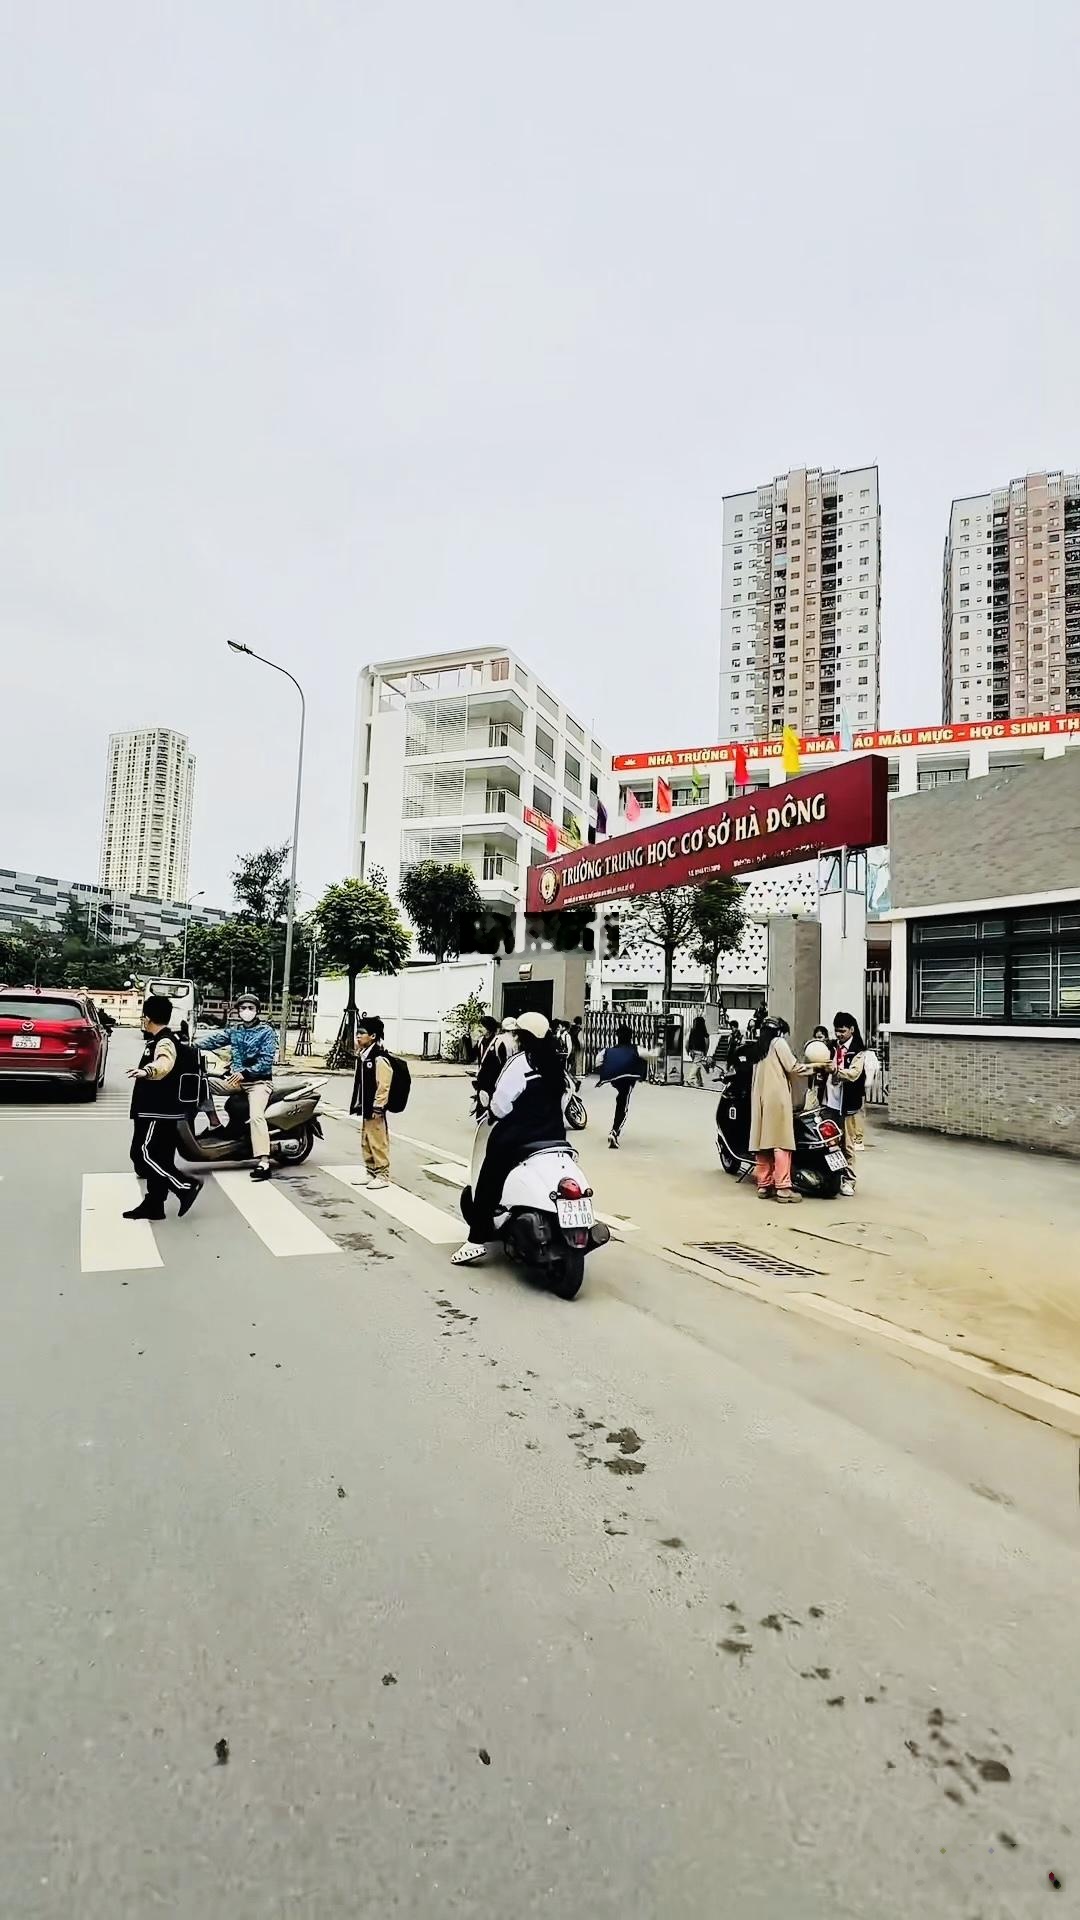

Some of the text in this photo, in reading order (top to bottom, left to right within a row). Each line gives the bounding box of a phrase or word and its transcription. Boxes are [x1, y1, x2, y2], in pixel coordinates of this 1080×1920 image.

[647, 750, 673, 765] NHÀ
[677, 747, 729, 763] TRƯỜNG
[805, 739, 836, 752] NHÀ
[917, 728, 954, 744] MỰC
[970, 724, 1006, 740] HỌC
[1010, 720, 1049, 735] SINH
[562, 856, 602, 887] TRƯỜNG
[604, 847, 643, 875] TRUNG
[647, 836, 677, 867] HỌC
[680, 828, 704, 855] CƠ
[707, 812, 731, 848] SỞ
[735, 805, 760, 842] HÀ
[766, 793, 826, 833] ĐÔNG
